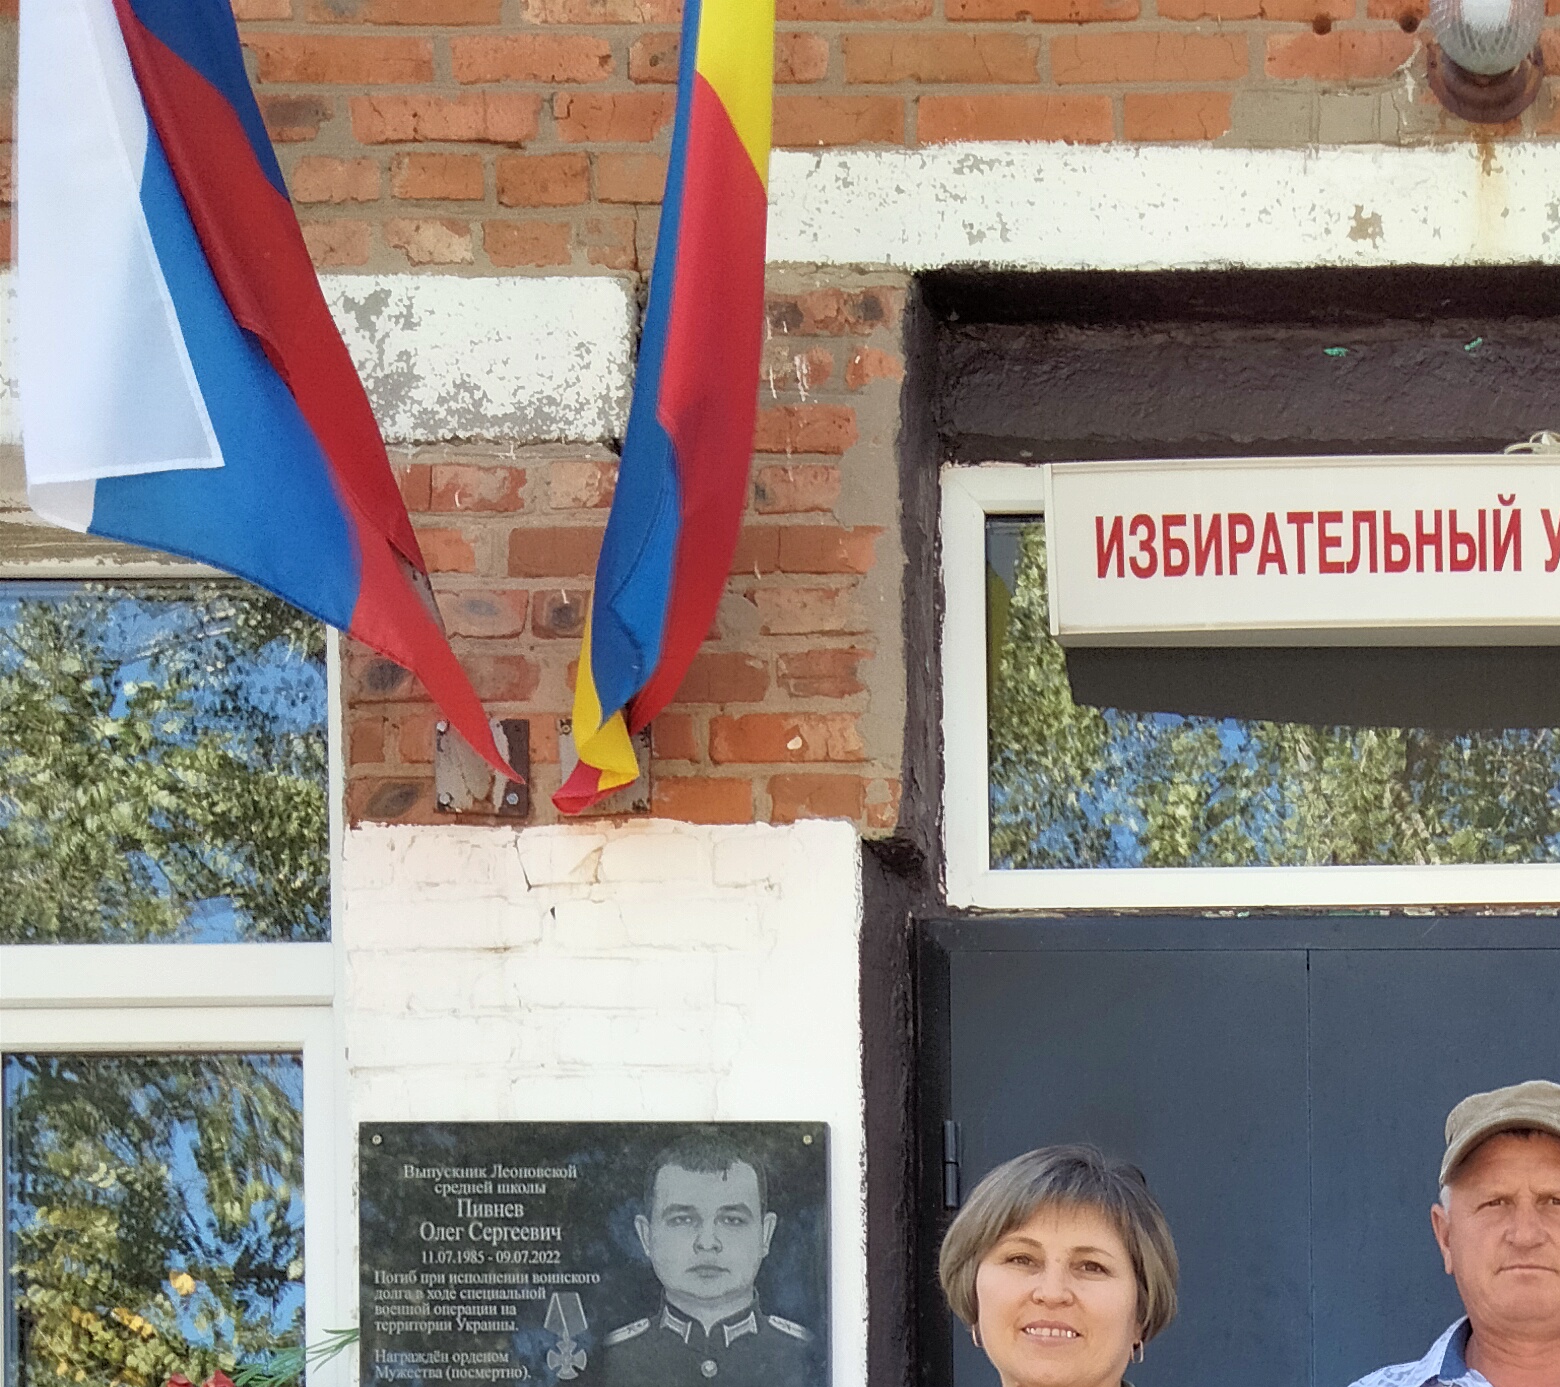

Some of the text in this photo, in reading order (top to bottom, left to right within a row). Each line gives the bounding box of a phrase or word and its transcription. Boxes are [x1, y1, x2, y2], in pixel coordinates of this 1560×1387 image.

[1095, 493, 1522, 579] ИЗБИРАТЕЛЬНЫЙ
[403, 1164, 577, 1181] Выпускник Леоновской
[434, 1181, 546, 1197] средней школы
[457, 1198, 524, 1218] Пивнев
[419, 1221, 562, 1246] Олег Сергеевич
[421, 1250, 485, 1264] 11.07.1985
[496, 1250, 561, 1264] 09.07.2022
[374, 1270, 600, 1288] Погиб при исполнении воинского
[374, 1289, 411, 1302] долга
[427, 1289, 457, 1301] ходе
[459, 1287, 546, 1301] специальной
[374, 1303, 517, 1320] военной операции на
[374, 1318, 519, 1335] территории Украины.
[374, 1349, 509, 1366] Награждён орденом
[374, 1365, 532, 1382] Мужества (посмертно).
